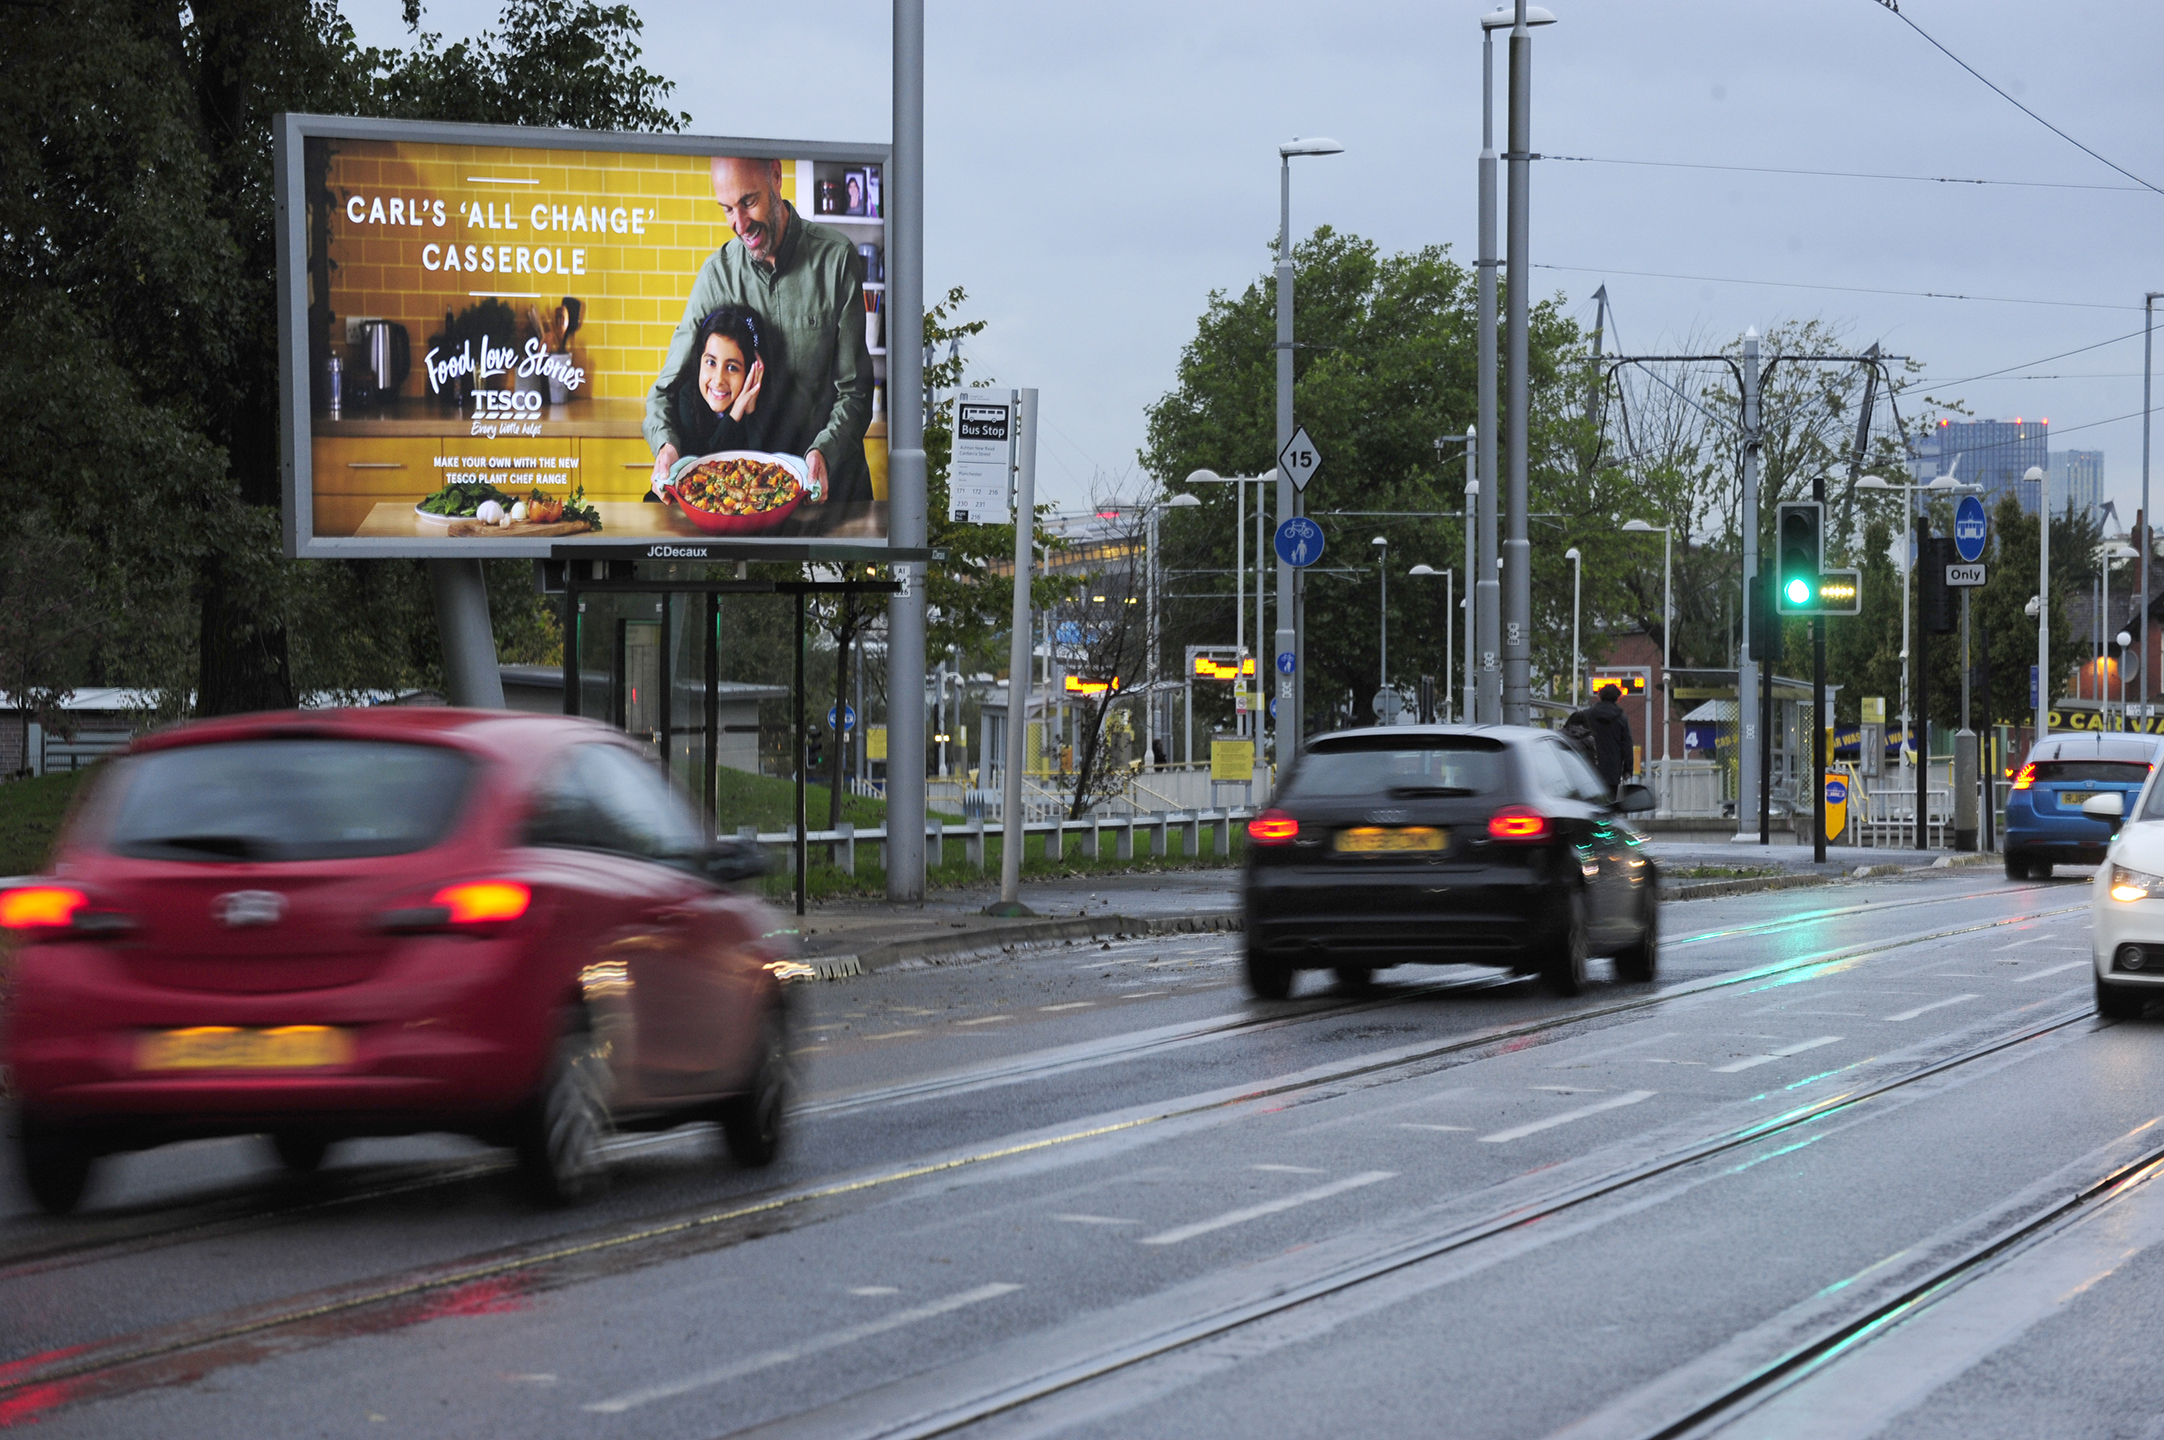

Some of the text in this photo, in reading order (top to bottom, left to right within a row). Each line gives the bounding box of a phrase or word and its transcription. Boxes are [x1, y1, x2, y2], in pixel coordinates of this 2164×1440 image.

[346, 195, 447, 227] CARL'S
[530, 203, 655, 234] CHANGE'
[422, 243, 586, 275] CASSEROLE
[424, 334, 586, 394] Food Love Stories
[470, 389, 543, 411] TESCO
[470, 420, 543, 440] Every little helps
[962, 424, 1005, 438] Bus Stop
[433, 456, 580, 469] MAKE YOUR OWN WITH THE NEW
[1290, 451, 1312, 469] 15
[446, 472, 567, 485] TESCO PLANT CHEF RANGE
[647, 546, 708, 557] JCDecaux
[1951, 569, 1981, 581] Only
[1685, 731, 1699, 747] 4
